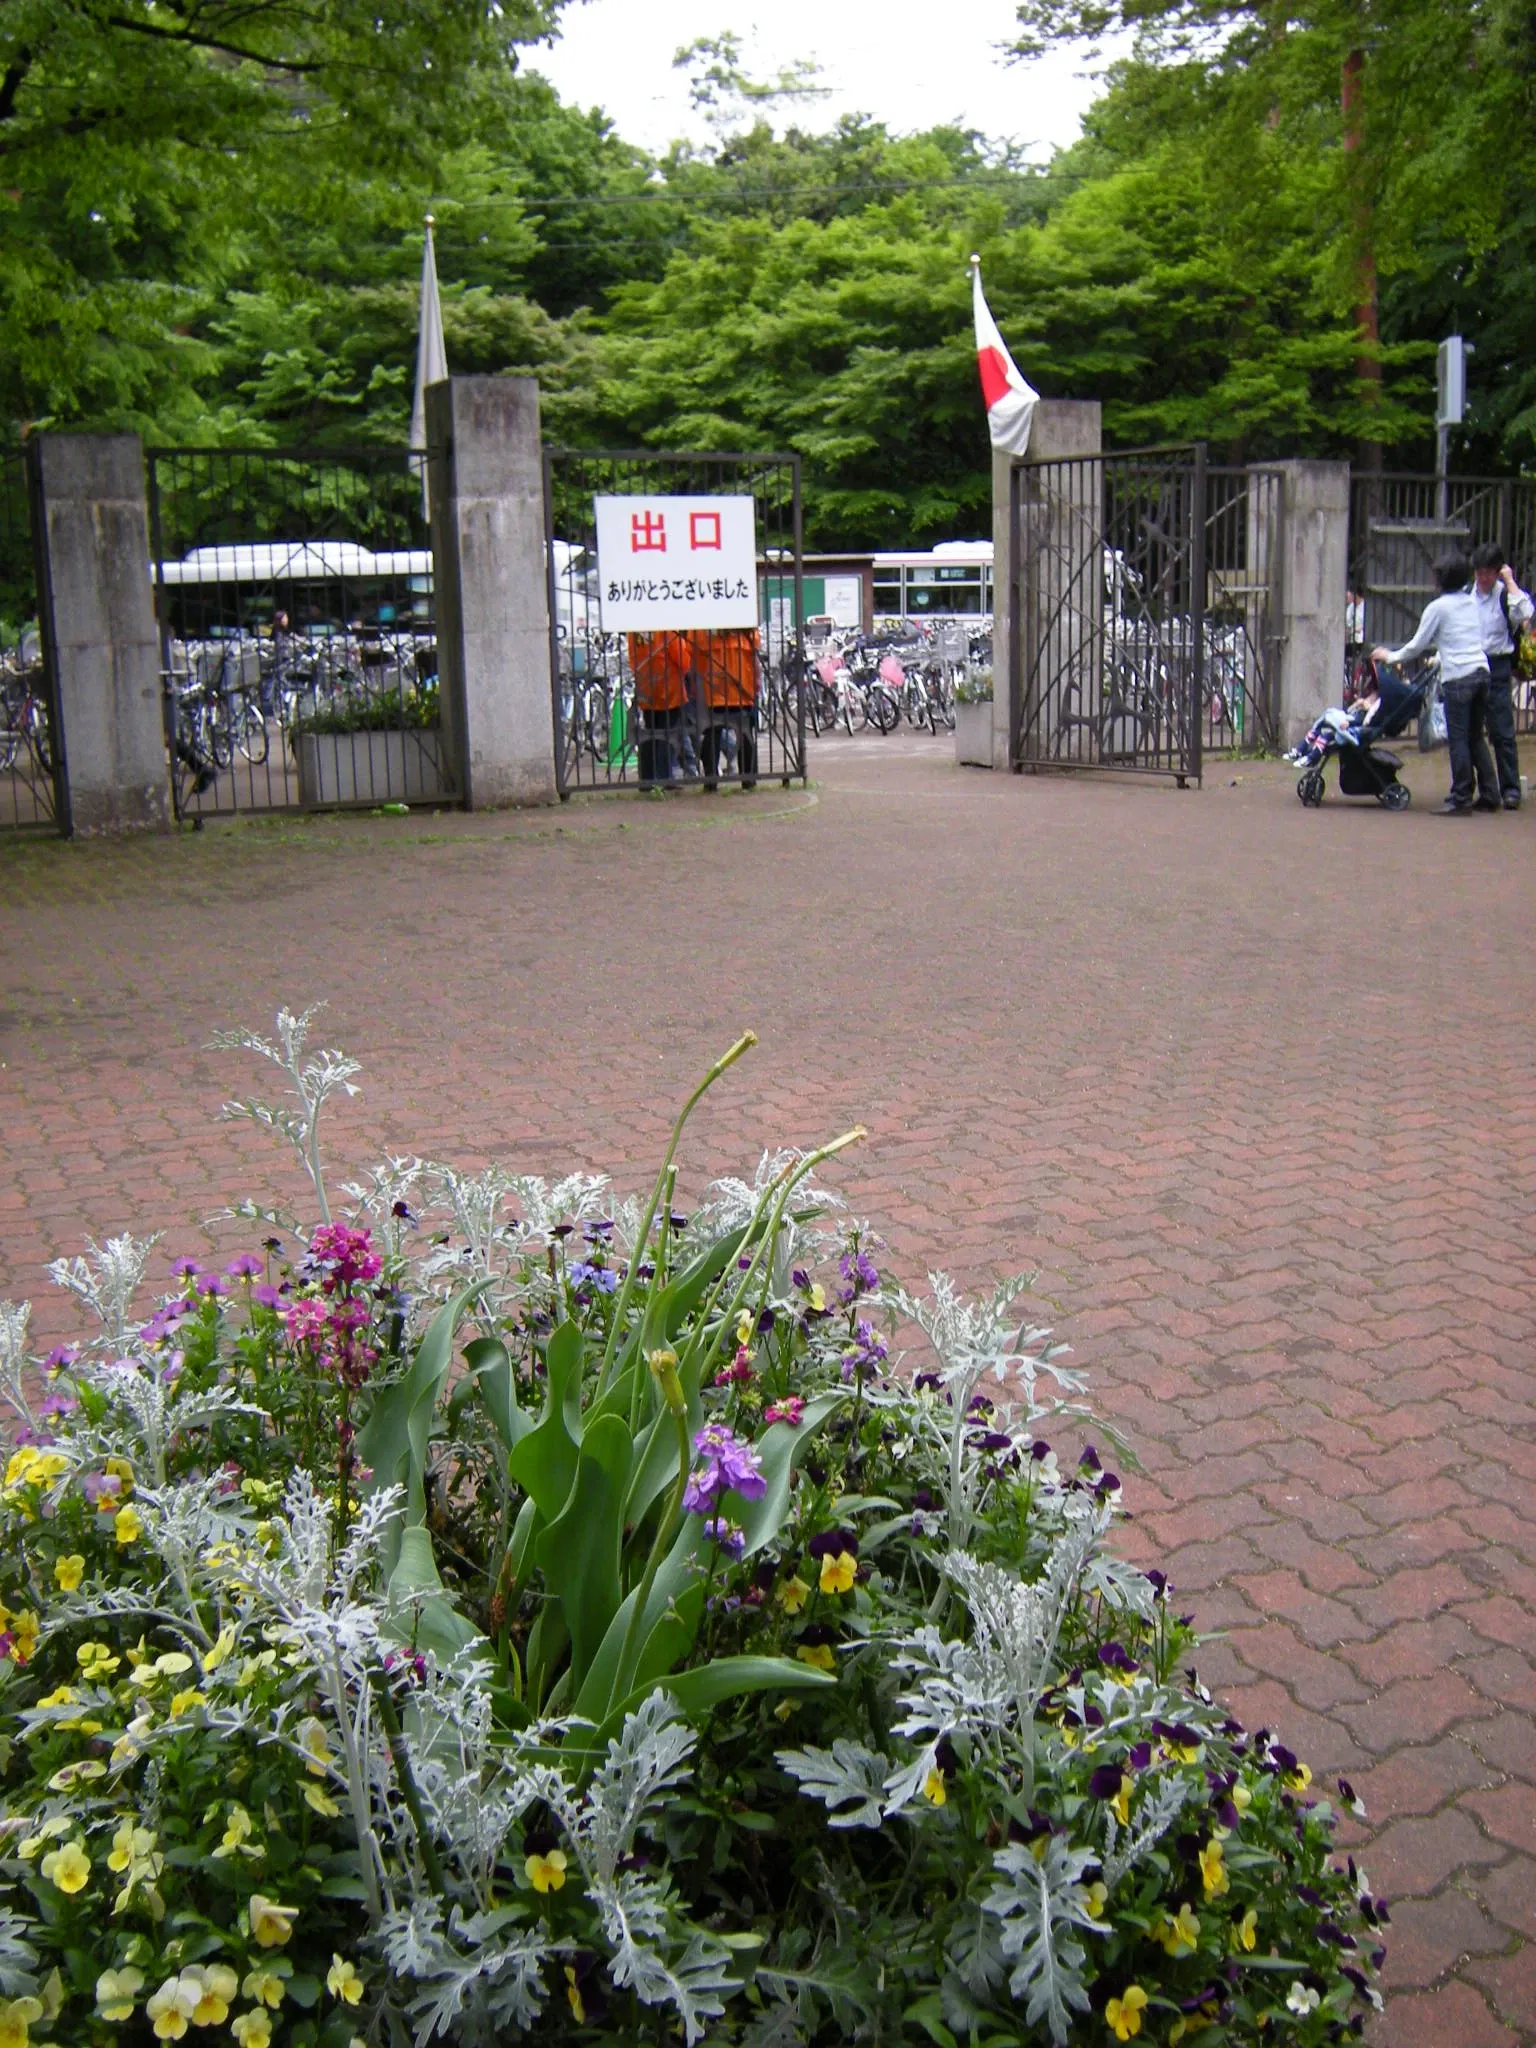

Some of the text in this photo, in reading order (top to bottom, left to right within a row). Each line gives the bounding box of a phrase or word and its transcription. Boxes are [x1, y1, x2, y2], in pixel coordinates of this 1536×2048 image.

[631, 510, 722, 553] 出口
[607, 578, 749, 602] ありがとうございました
